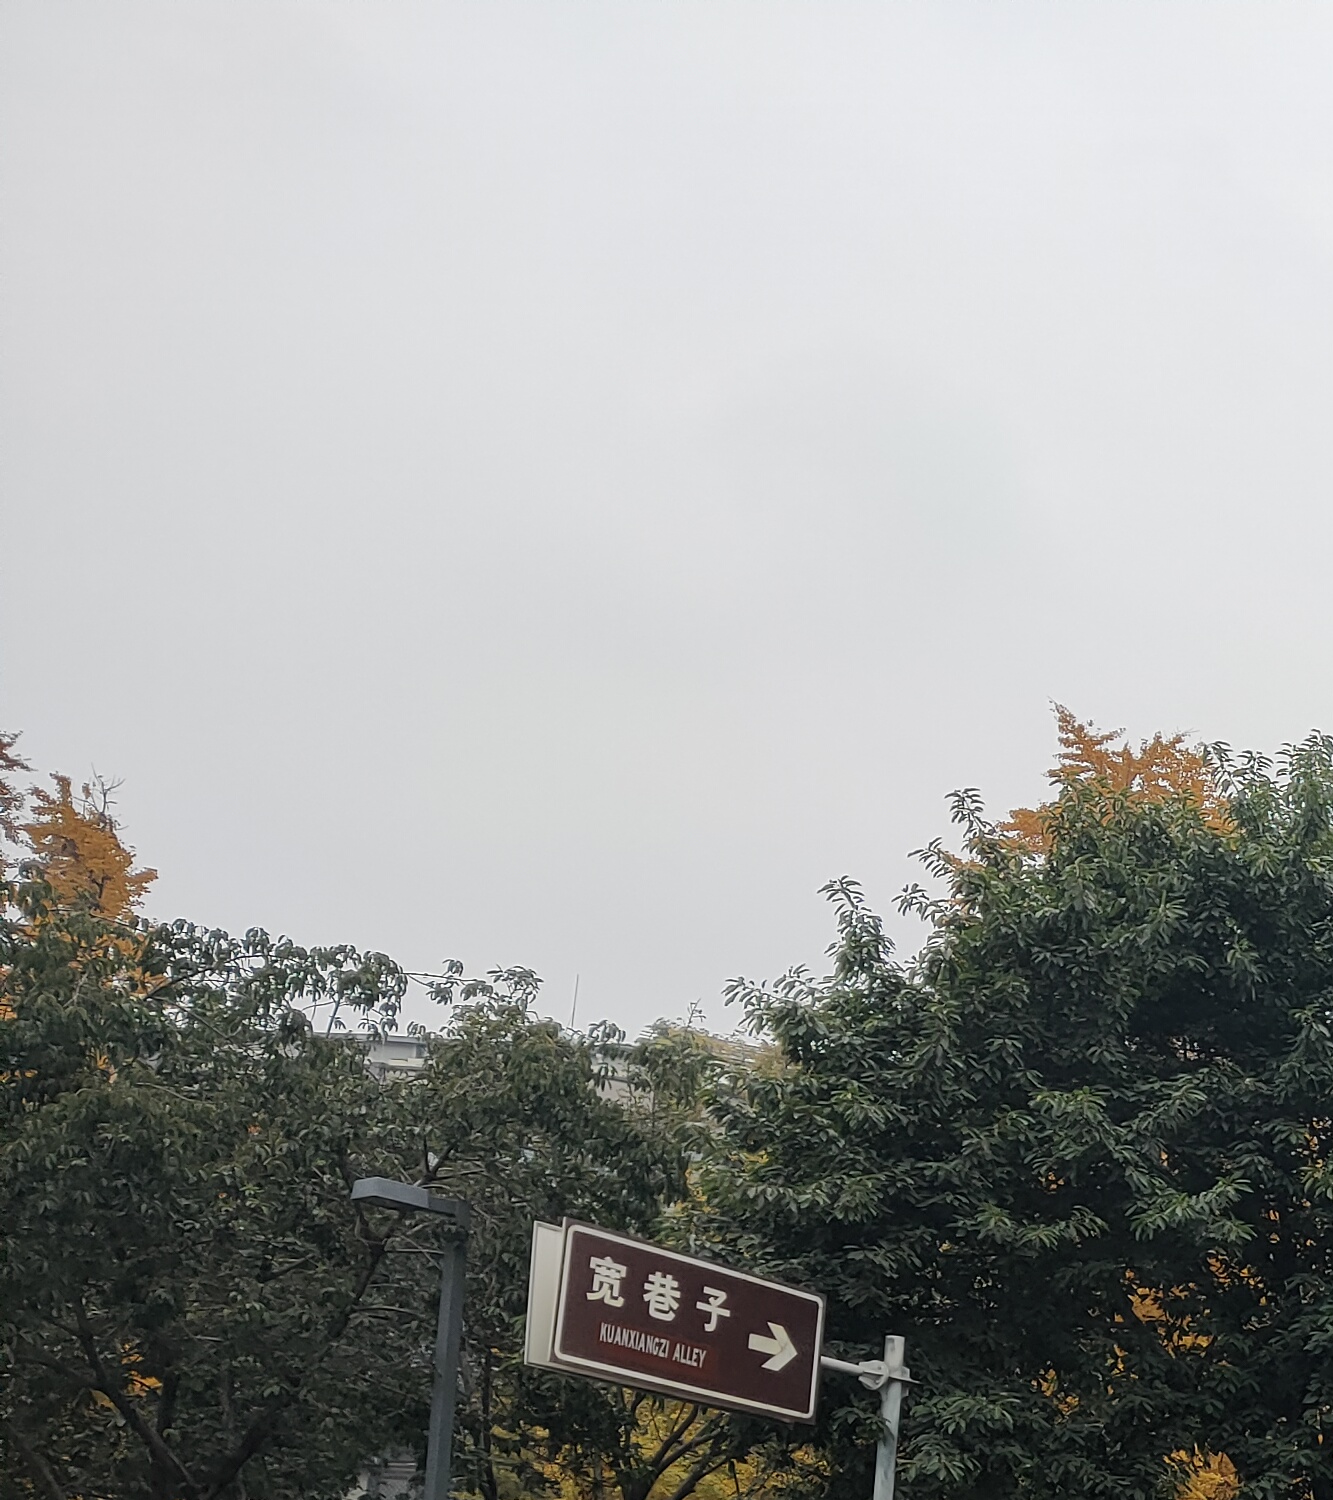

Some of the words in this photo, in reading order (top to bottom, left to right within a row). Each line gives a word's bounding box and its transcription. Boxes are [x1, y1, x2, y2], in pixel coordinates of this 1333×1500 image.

[587, 1256, 731, 1332] 宽巷子
[600, 1322, 669, 1358] KUANXIANGZI
[672, 1343, 707, 1368] ALLEY
